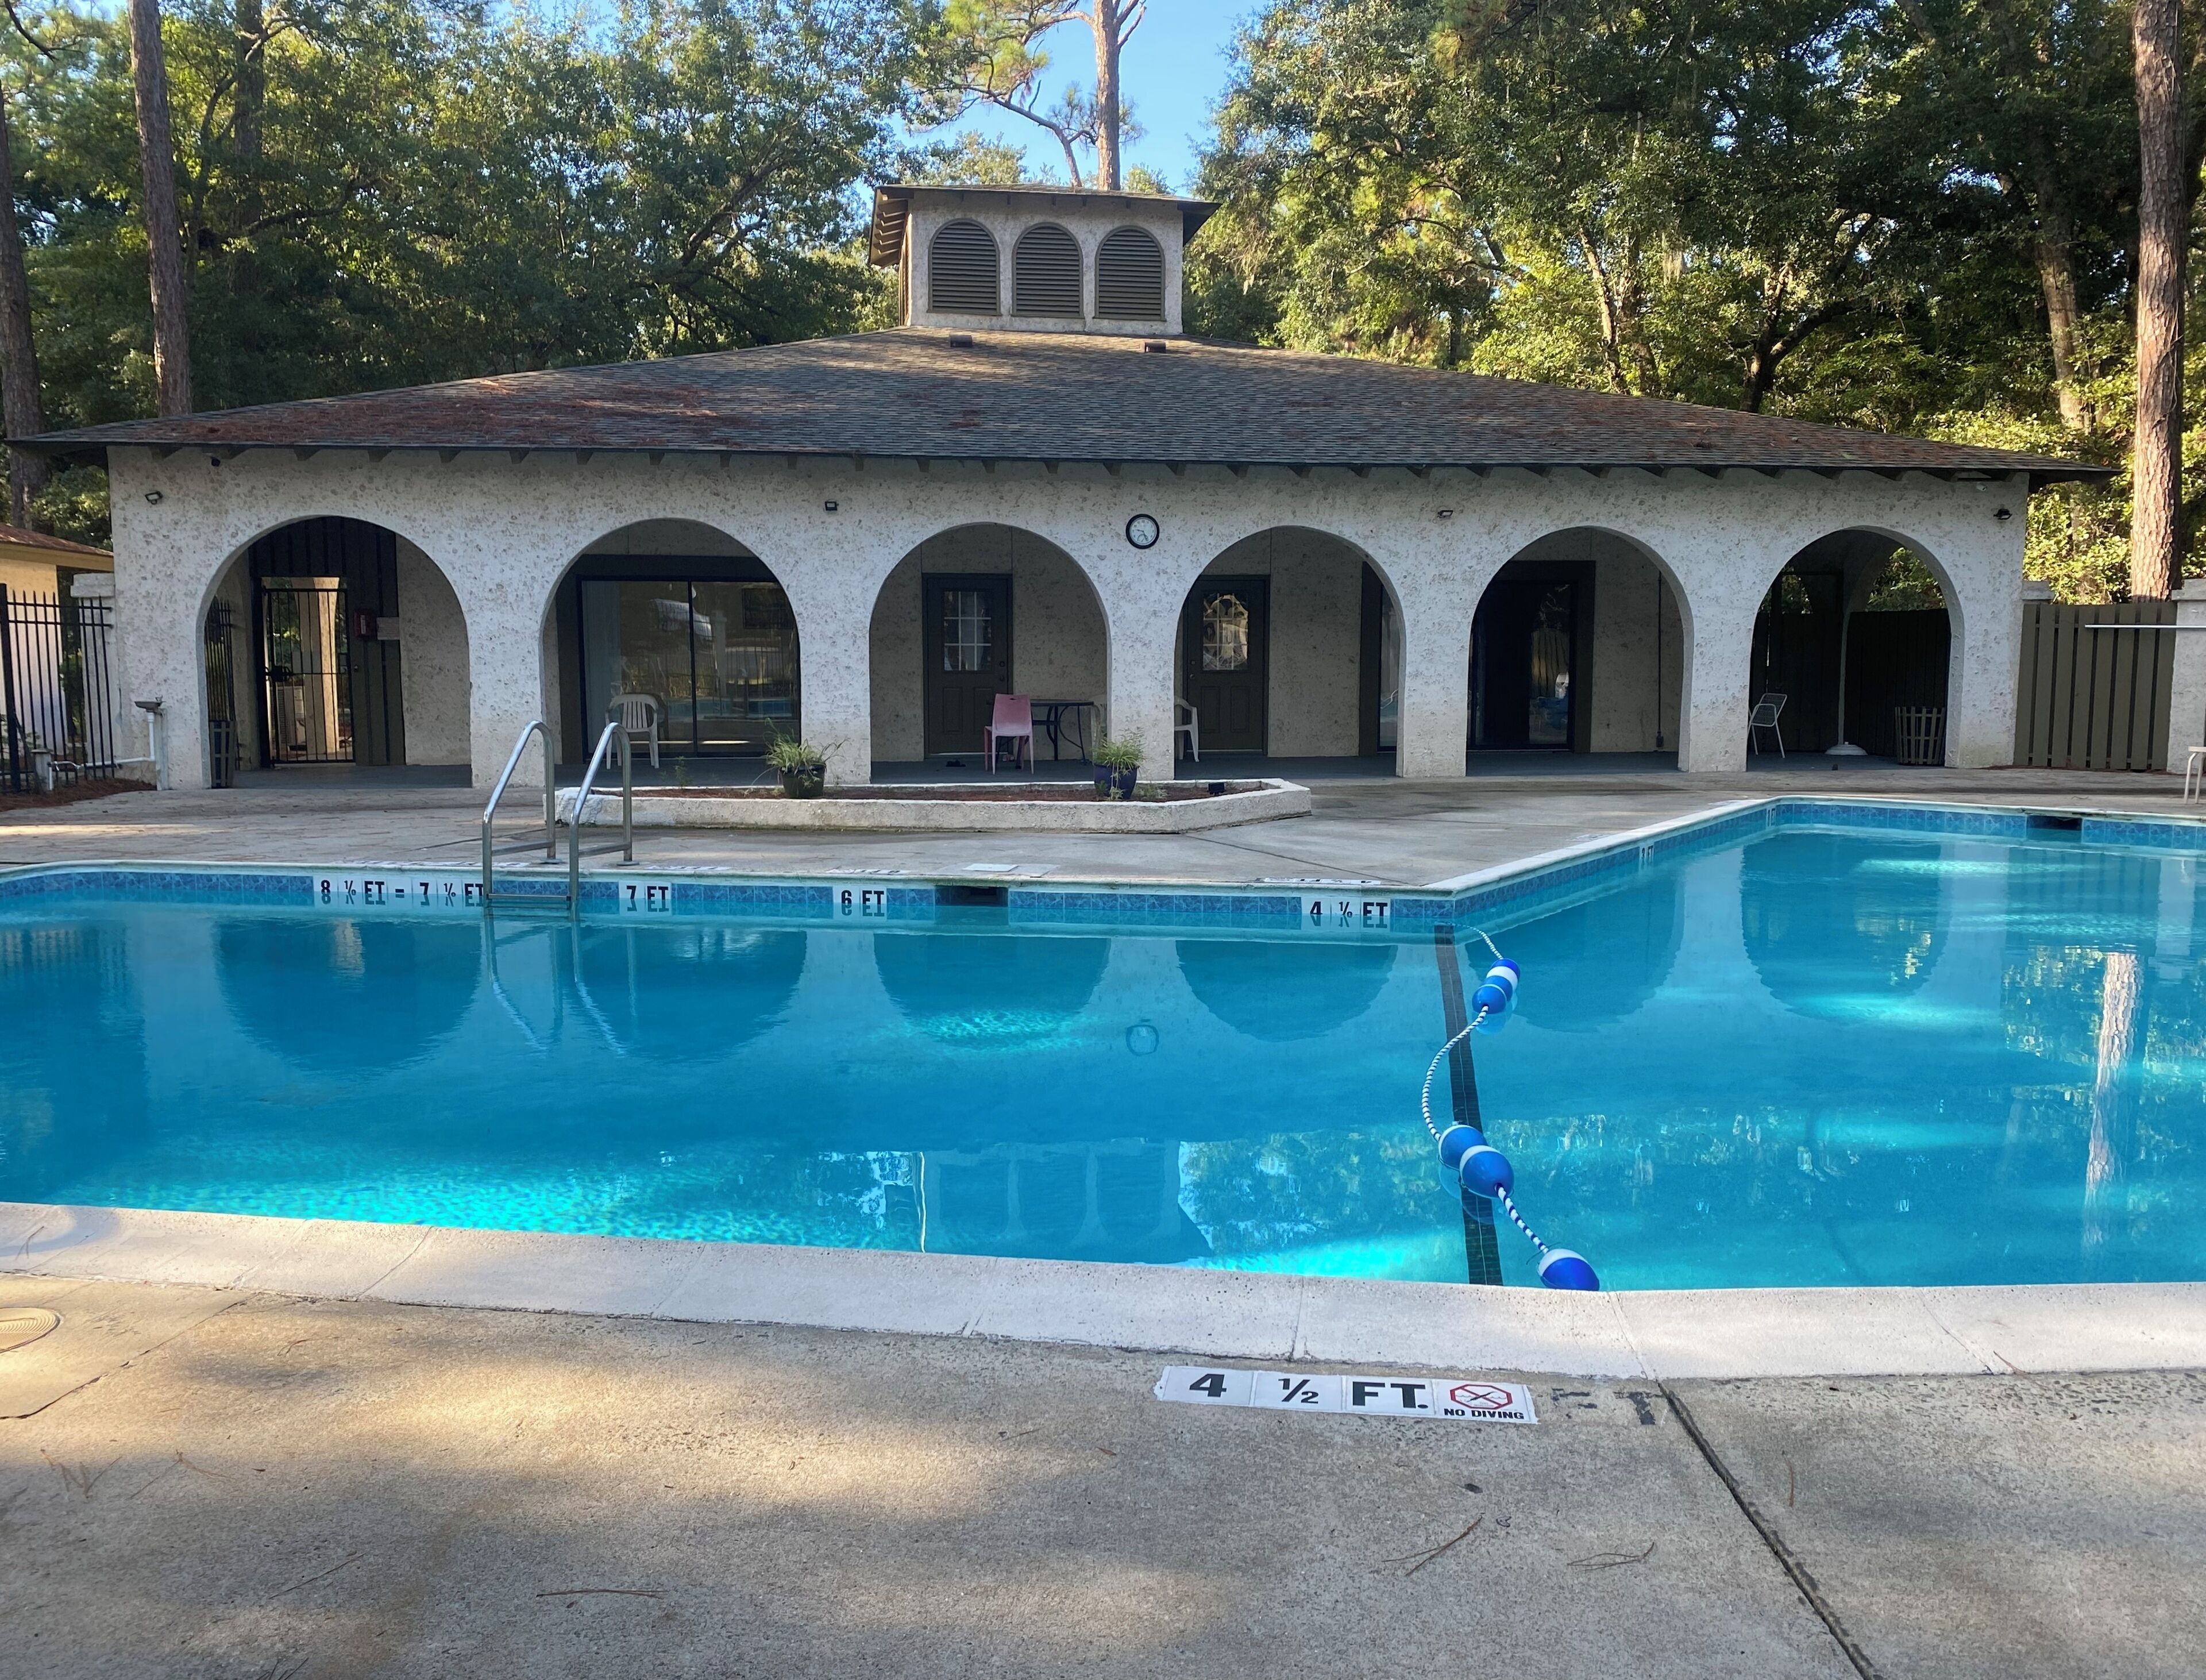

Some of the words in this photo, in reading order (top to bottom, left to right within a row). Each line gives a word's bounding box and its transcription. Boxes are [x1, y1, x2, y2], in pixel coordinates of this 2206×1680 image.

[321, 880, 330, 895] 8
[626, 885, 637, 900] 7
[647, 885, 669, 900] FT
[841, 890, 852, 904] 6
[862, 890, 885, 905] FT
[1310, 901, 1323, 915] 4
[1363, 901, 1388, 917] FT
[1189, 1373, 1227, 1397] 4
[1352, 1381, 1429, 1409] FT.
[1444, 1408, 1465, 1416] NO
[1471, 1410, 1524, 1420] DIVING
